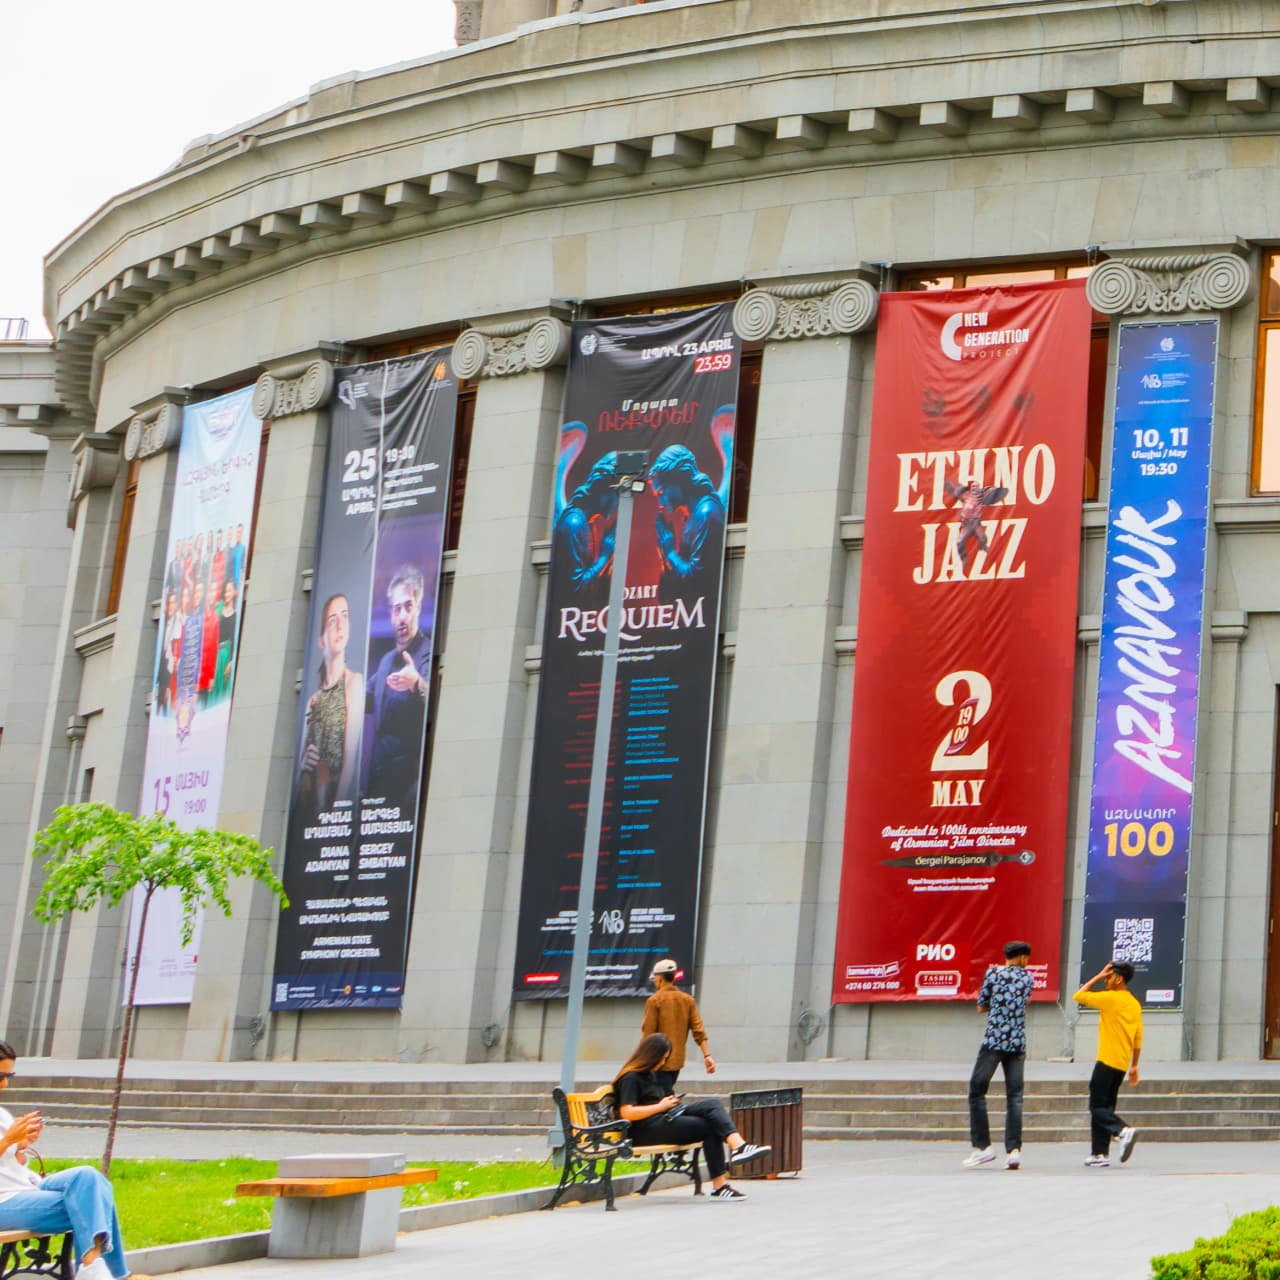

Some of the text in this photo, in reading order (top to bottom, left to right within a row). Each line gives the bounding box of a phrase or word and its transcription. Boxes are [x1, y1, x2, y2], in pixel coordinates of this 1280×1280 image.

[964, 312, 988, 327] NEW
[683, 342, 698, 355] 23
[698, 337, 734, 353] APRIL
[964, 328, 1030, 347] GENERATION
[695, 354, 731, 372] 23:59
[1132, 427, 1189, 449] 10, 11
[1168, 449, 1187, 459] May
[342, 448, 377, 483] 25
[1140, 462, 1178, 476] 19:30
[893, 443, 1056, 513] ETHNO
[913, 518, 1028, 585] JAZZ
[622, 584, 659, 601] OZART
[1112, 499, 1193, 794] AZNAVOUR
[930, 670, 992, 772] 2
[154, 776, 171, 816] 15
[930, 779, 986, 807] MAY
[928, 825, 938, 837] to
[941, 824, 968, 836] 100th
[1104, 822, 1174, 857] 100
[321, 845, 349, 858] DIANA
[359, 842, 394, 856] SERGEY
[305, 858, 349, 872] ADAMYAN
